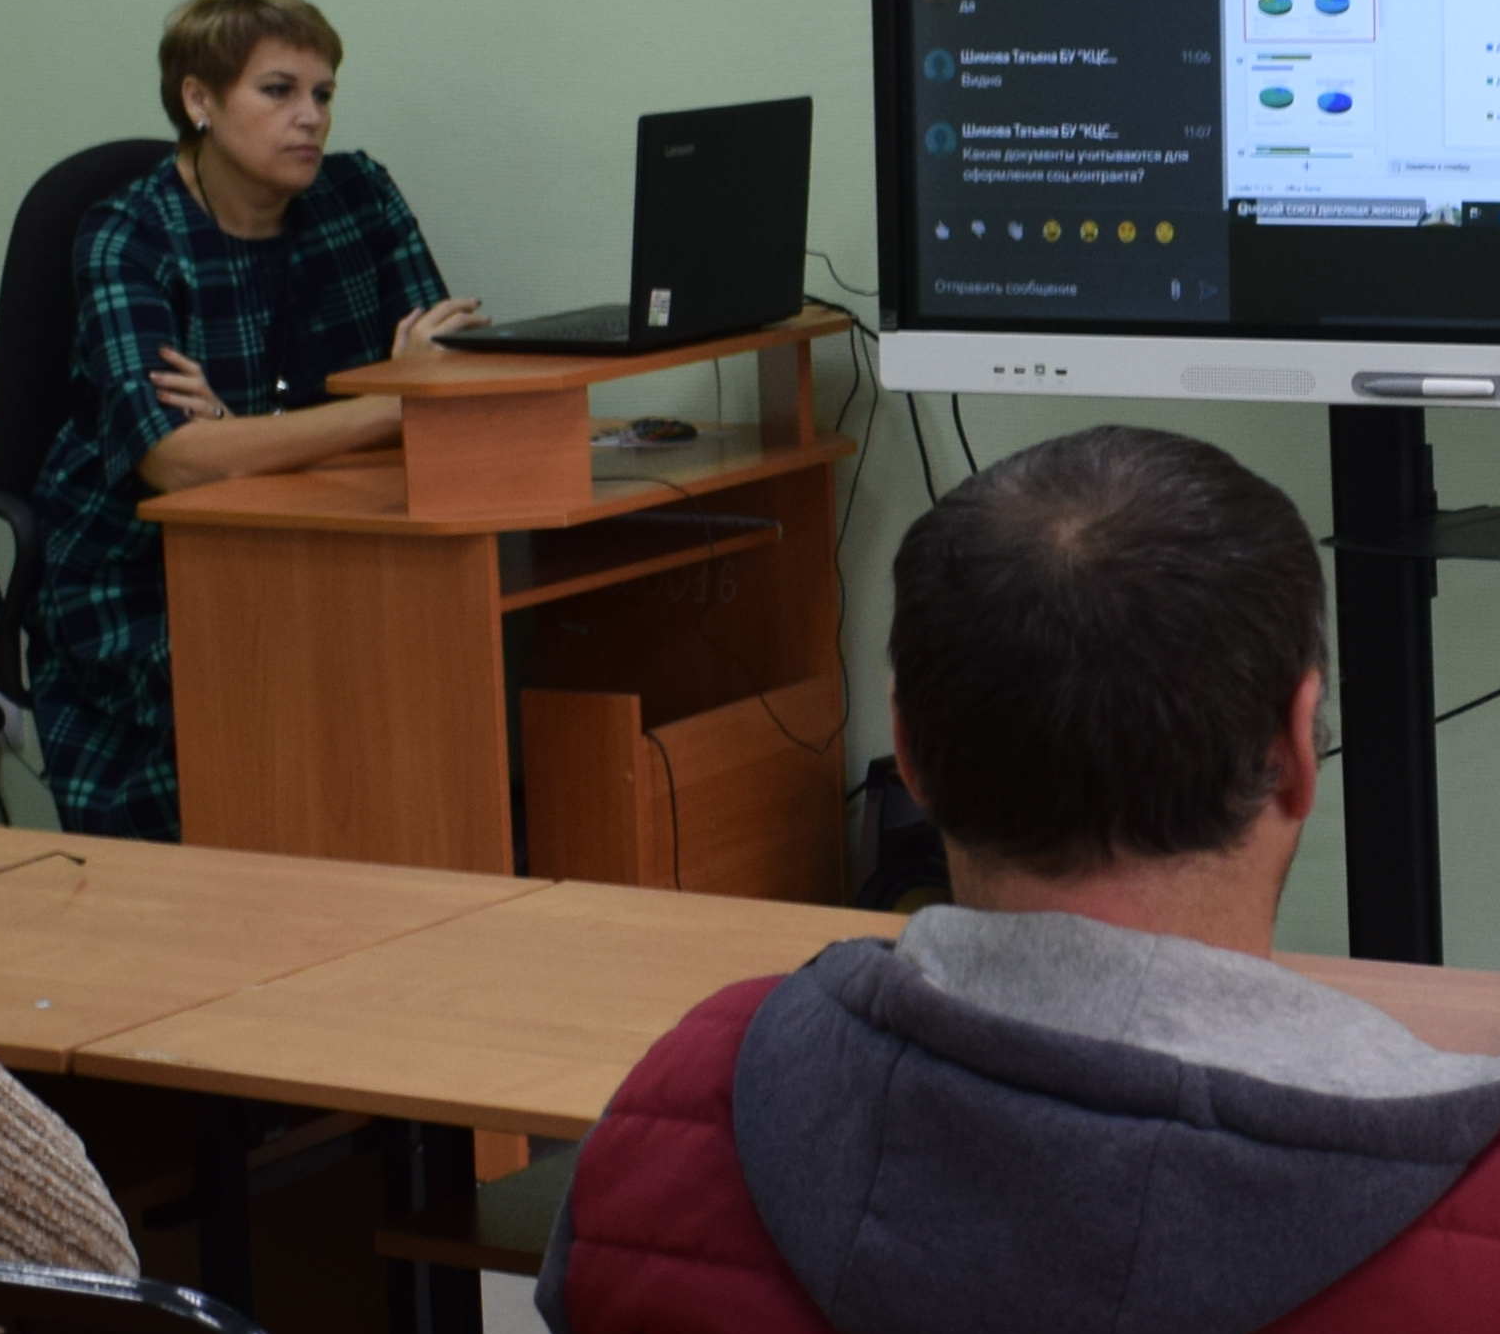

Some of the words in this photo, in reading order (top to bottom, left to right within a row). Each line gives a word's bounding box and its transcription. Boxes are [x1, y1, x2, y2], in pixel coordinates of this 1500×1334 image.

[1003, 147, 1076, 166] документы
[933, 278, 1004, 297] Отправить
[1004, 278, 1079, 297] сообщение
